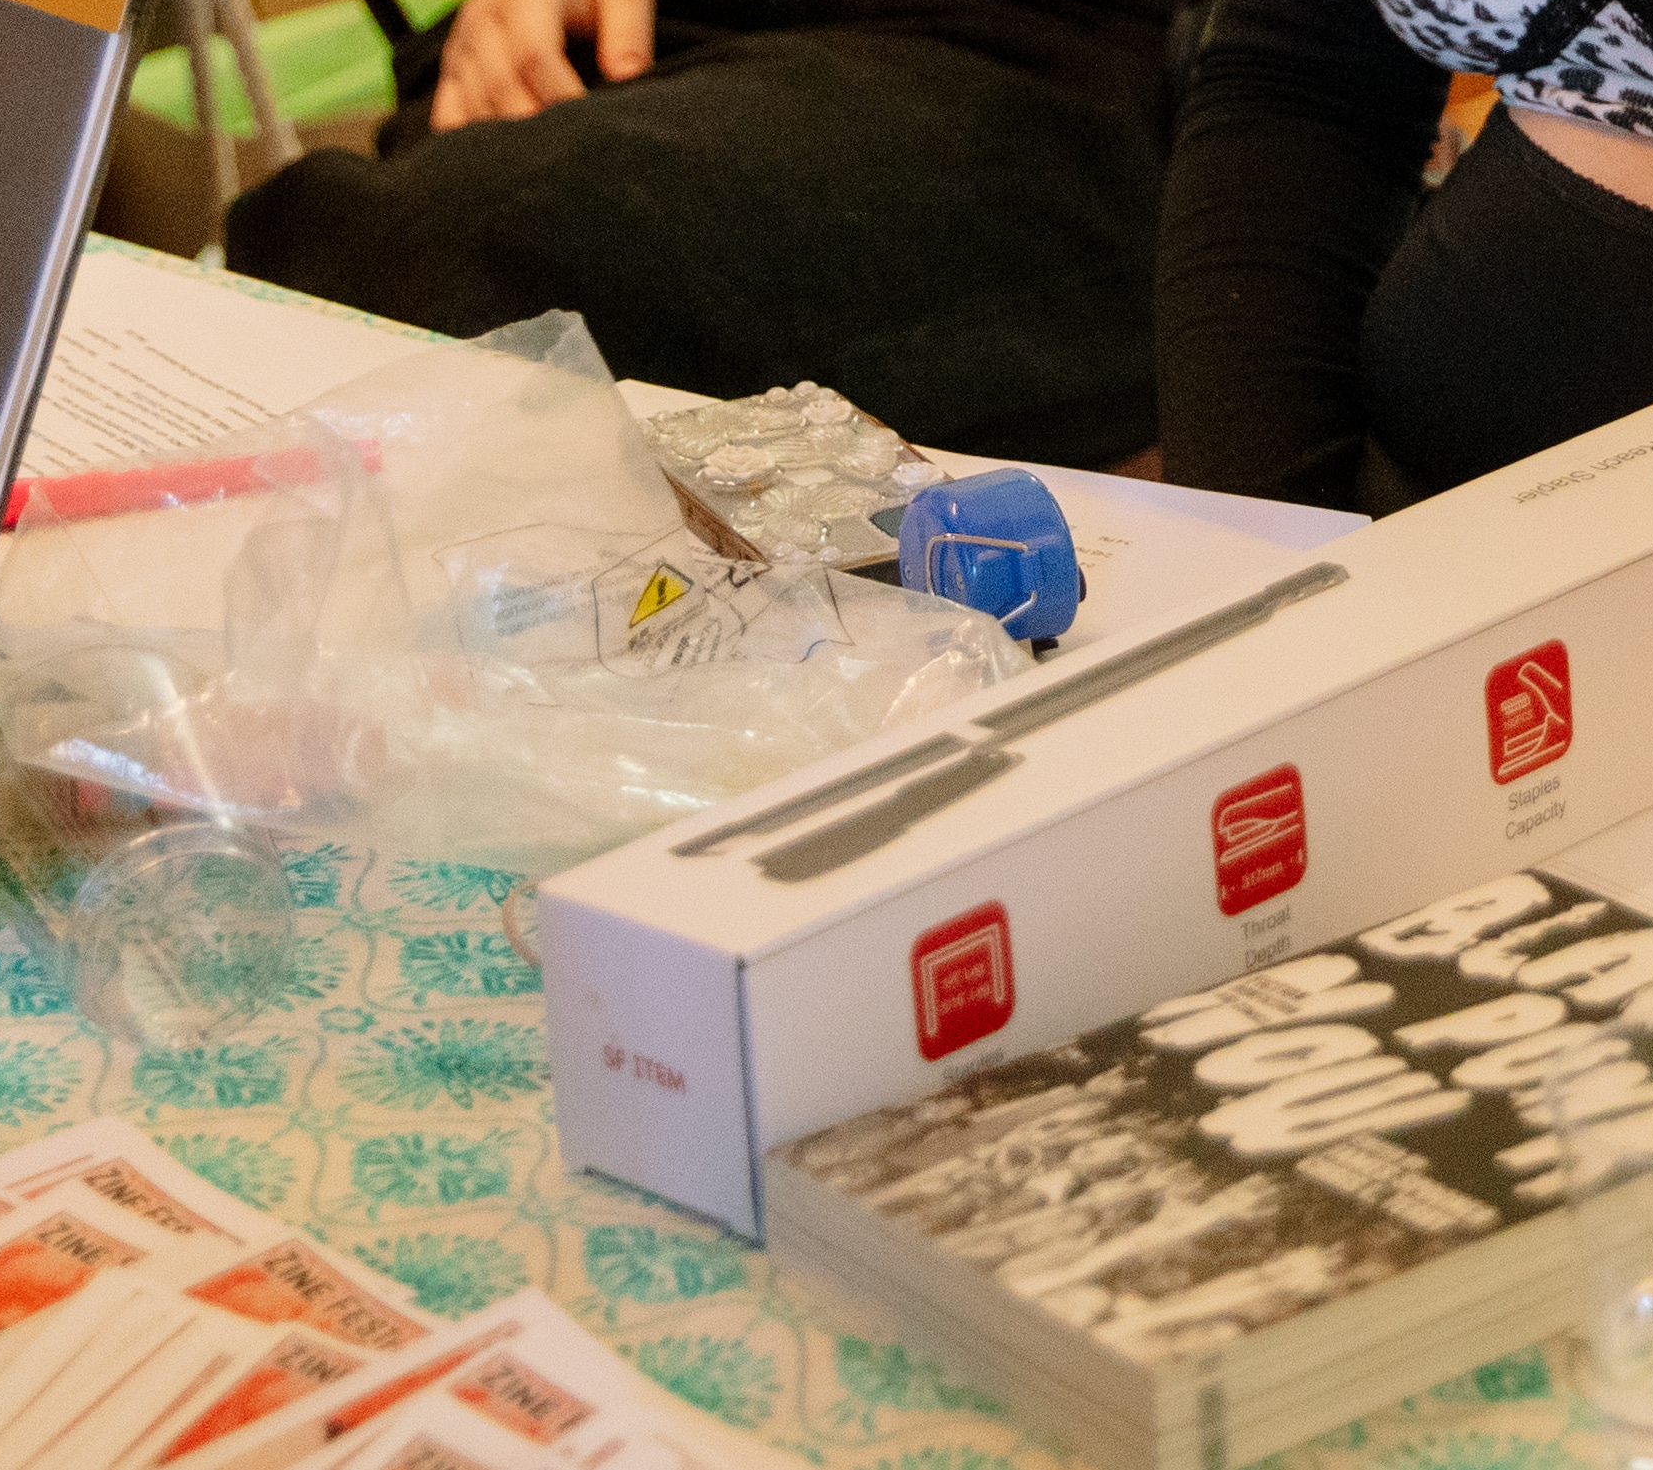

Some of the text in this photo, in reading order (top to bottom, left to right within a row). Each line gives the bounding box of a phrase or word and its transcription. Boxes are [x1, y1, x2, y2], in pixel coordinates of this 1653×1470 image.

[1510, 469, 1596, 505] Stapler
[1508, 775, 1561, 812] Staples
[1505, 800, 1567, 841] Capacity
[1240, 903, 1292, 939] Throat
[1245, 934, 1292, 971] Depth
